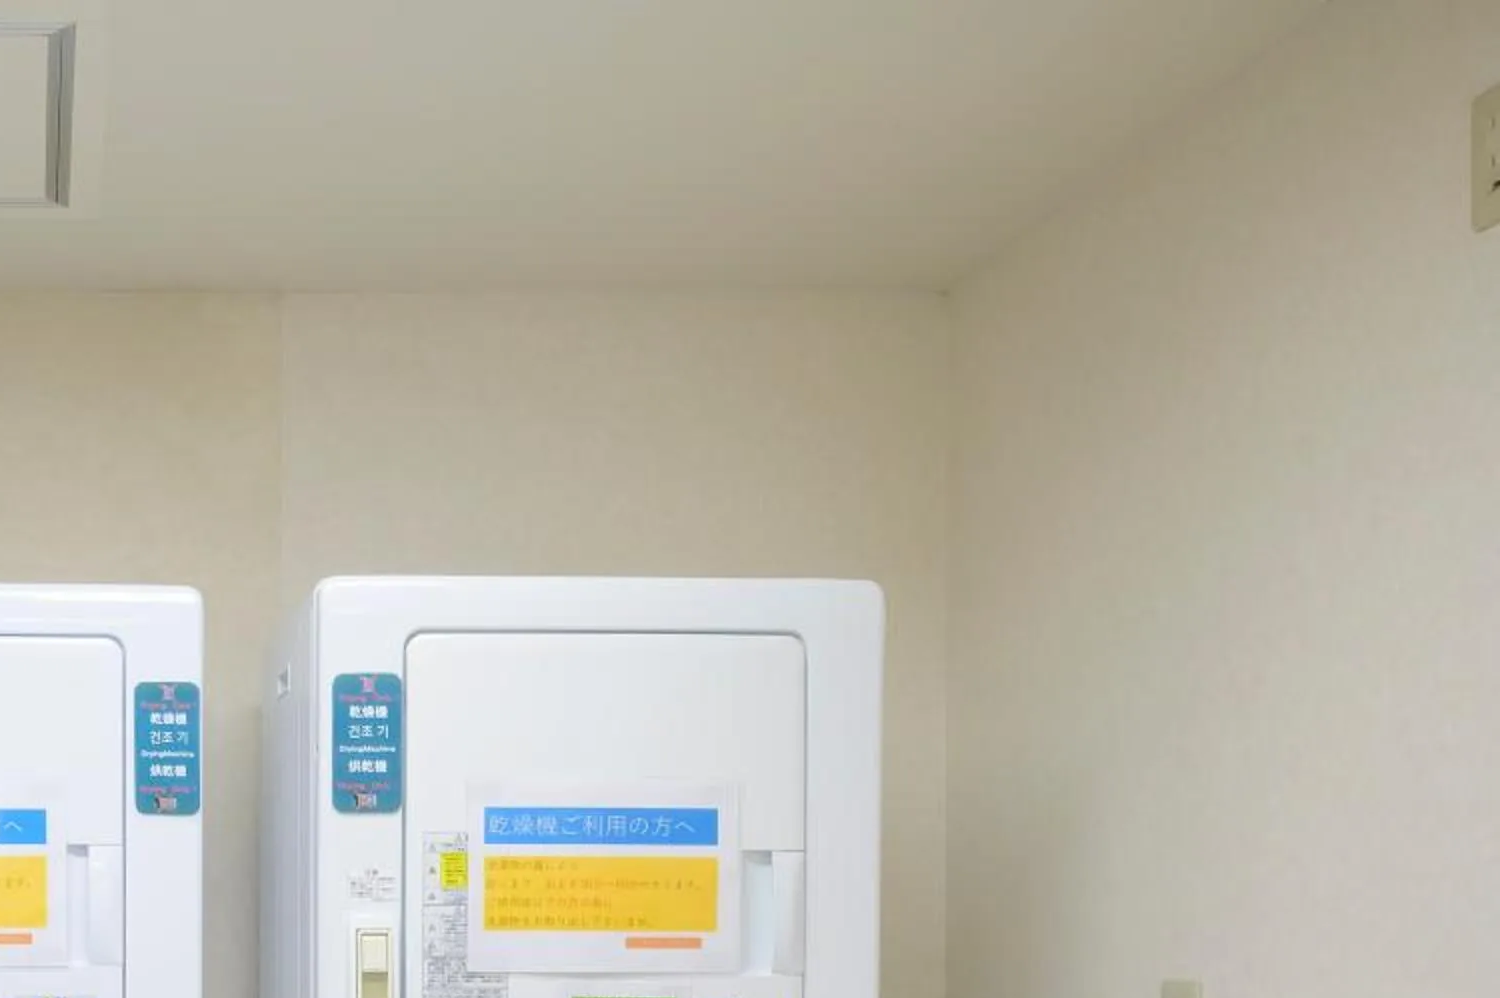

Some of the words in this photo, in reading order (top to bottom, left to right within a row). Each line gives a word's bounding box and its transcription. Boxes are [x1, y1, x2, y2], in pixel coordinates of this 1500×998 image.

[488, 814, 696, 837] 乾燥機ご利用の方へ
